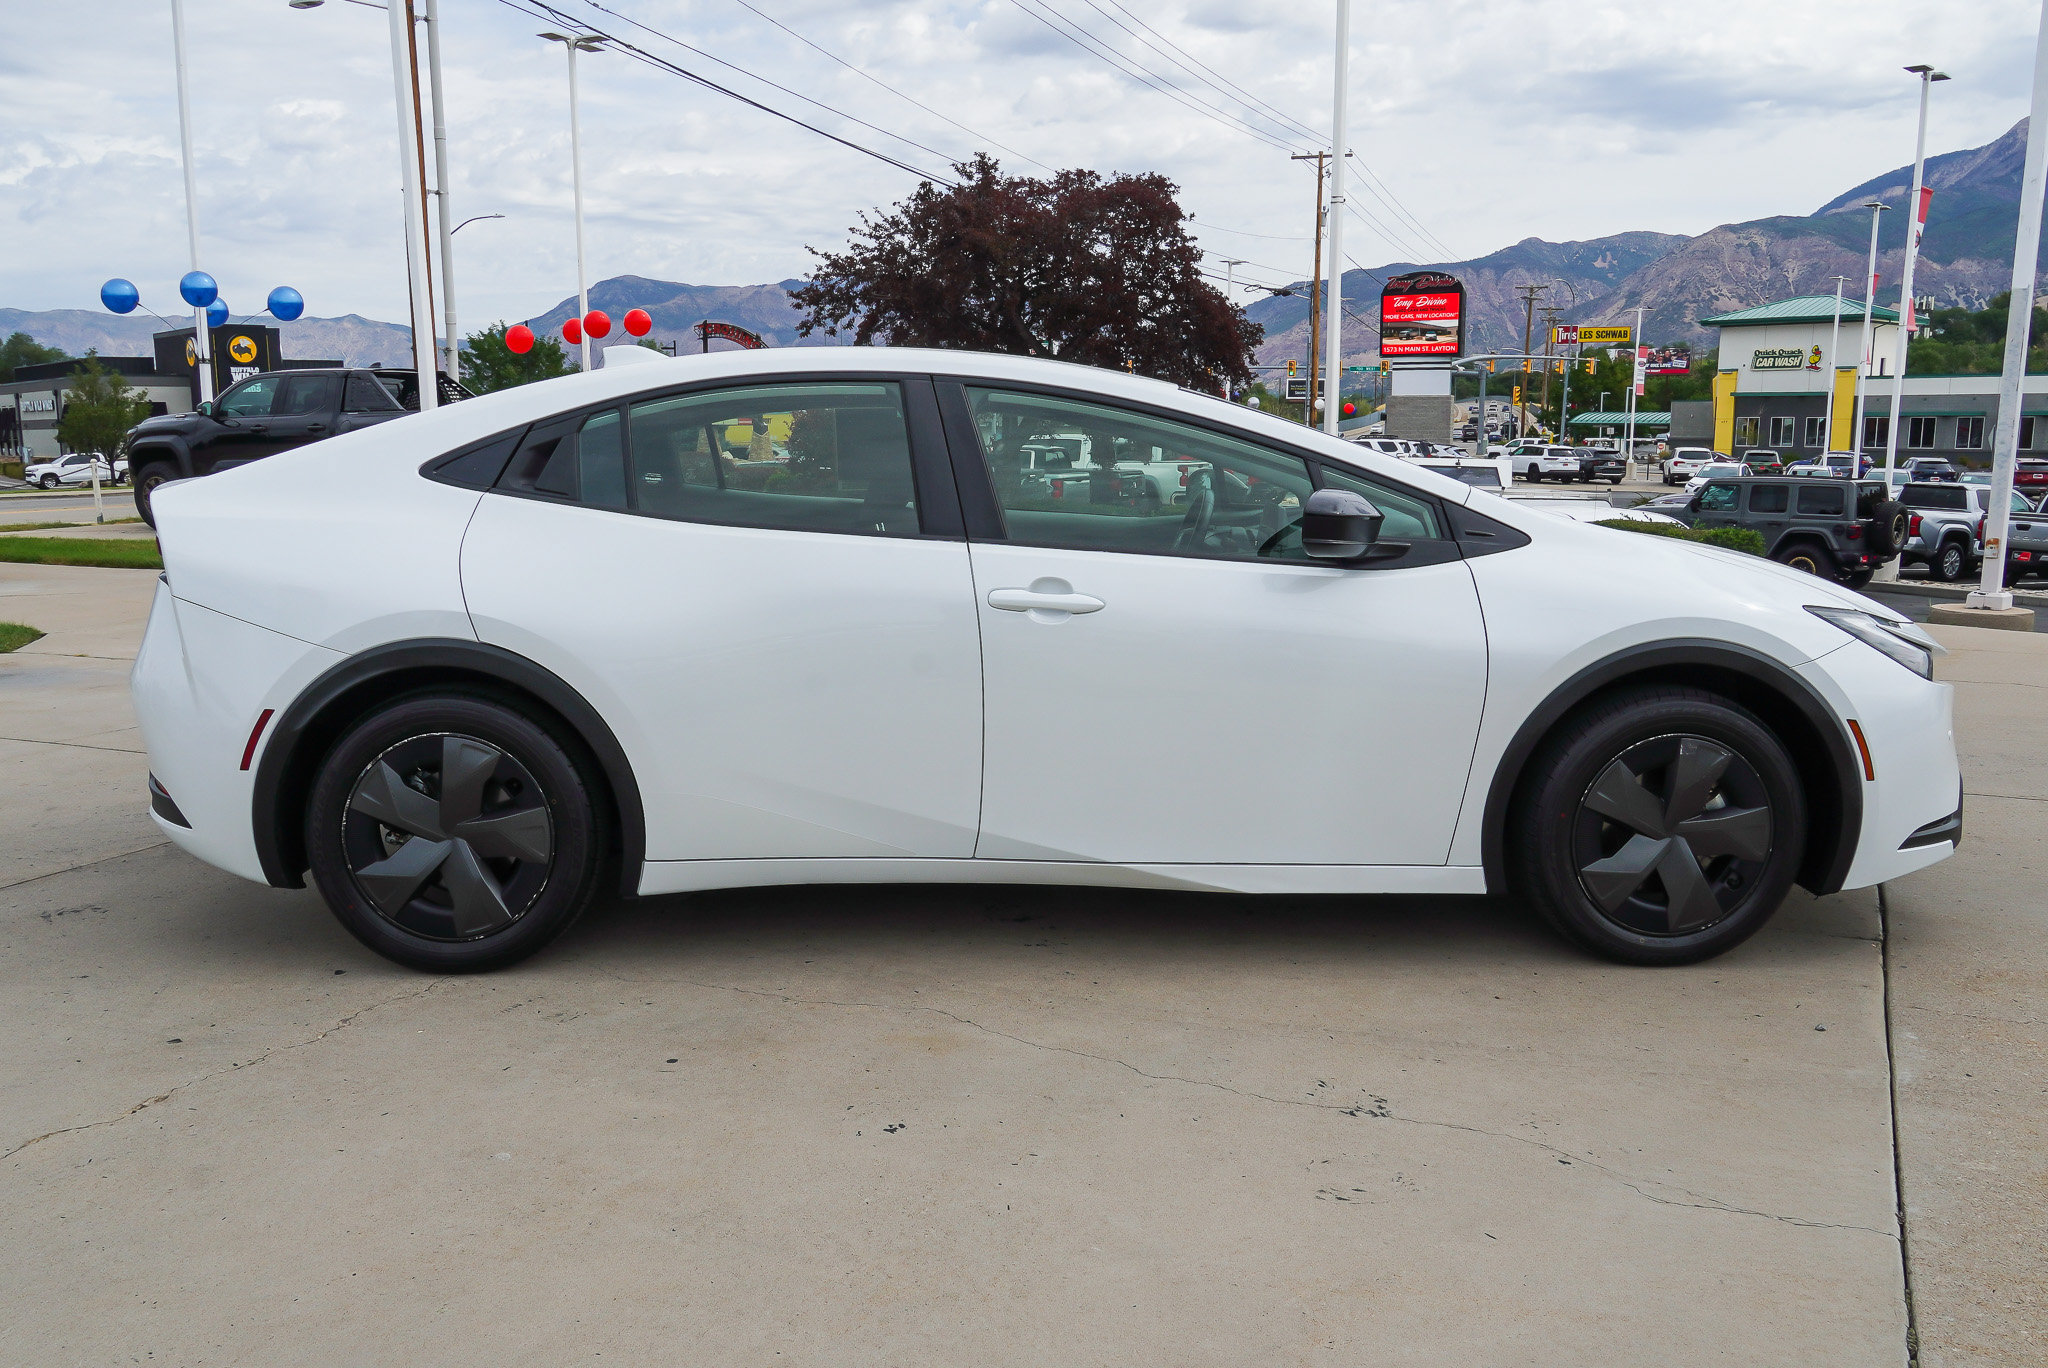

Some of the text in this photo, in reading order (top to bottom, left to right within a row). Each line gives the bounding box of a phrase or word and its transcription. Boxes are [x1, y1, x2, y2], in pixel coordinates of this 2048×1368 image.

[1387, 275, 1414, 292] Tony
[1393, 296, 1413, 309] Tony
[1579, 329, 1628, 339] LES SCHWAB
[1778, 348, 1803, 356] Quack
[1755, 356, 1802, 367] CAR WASH
